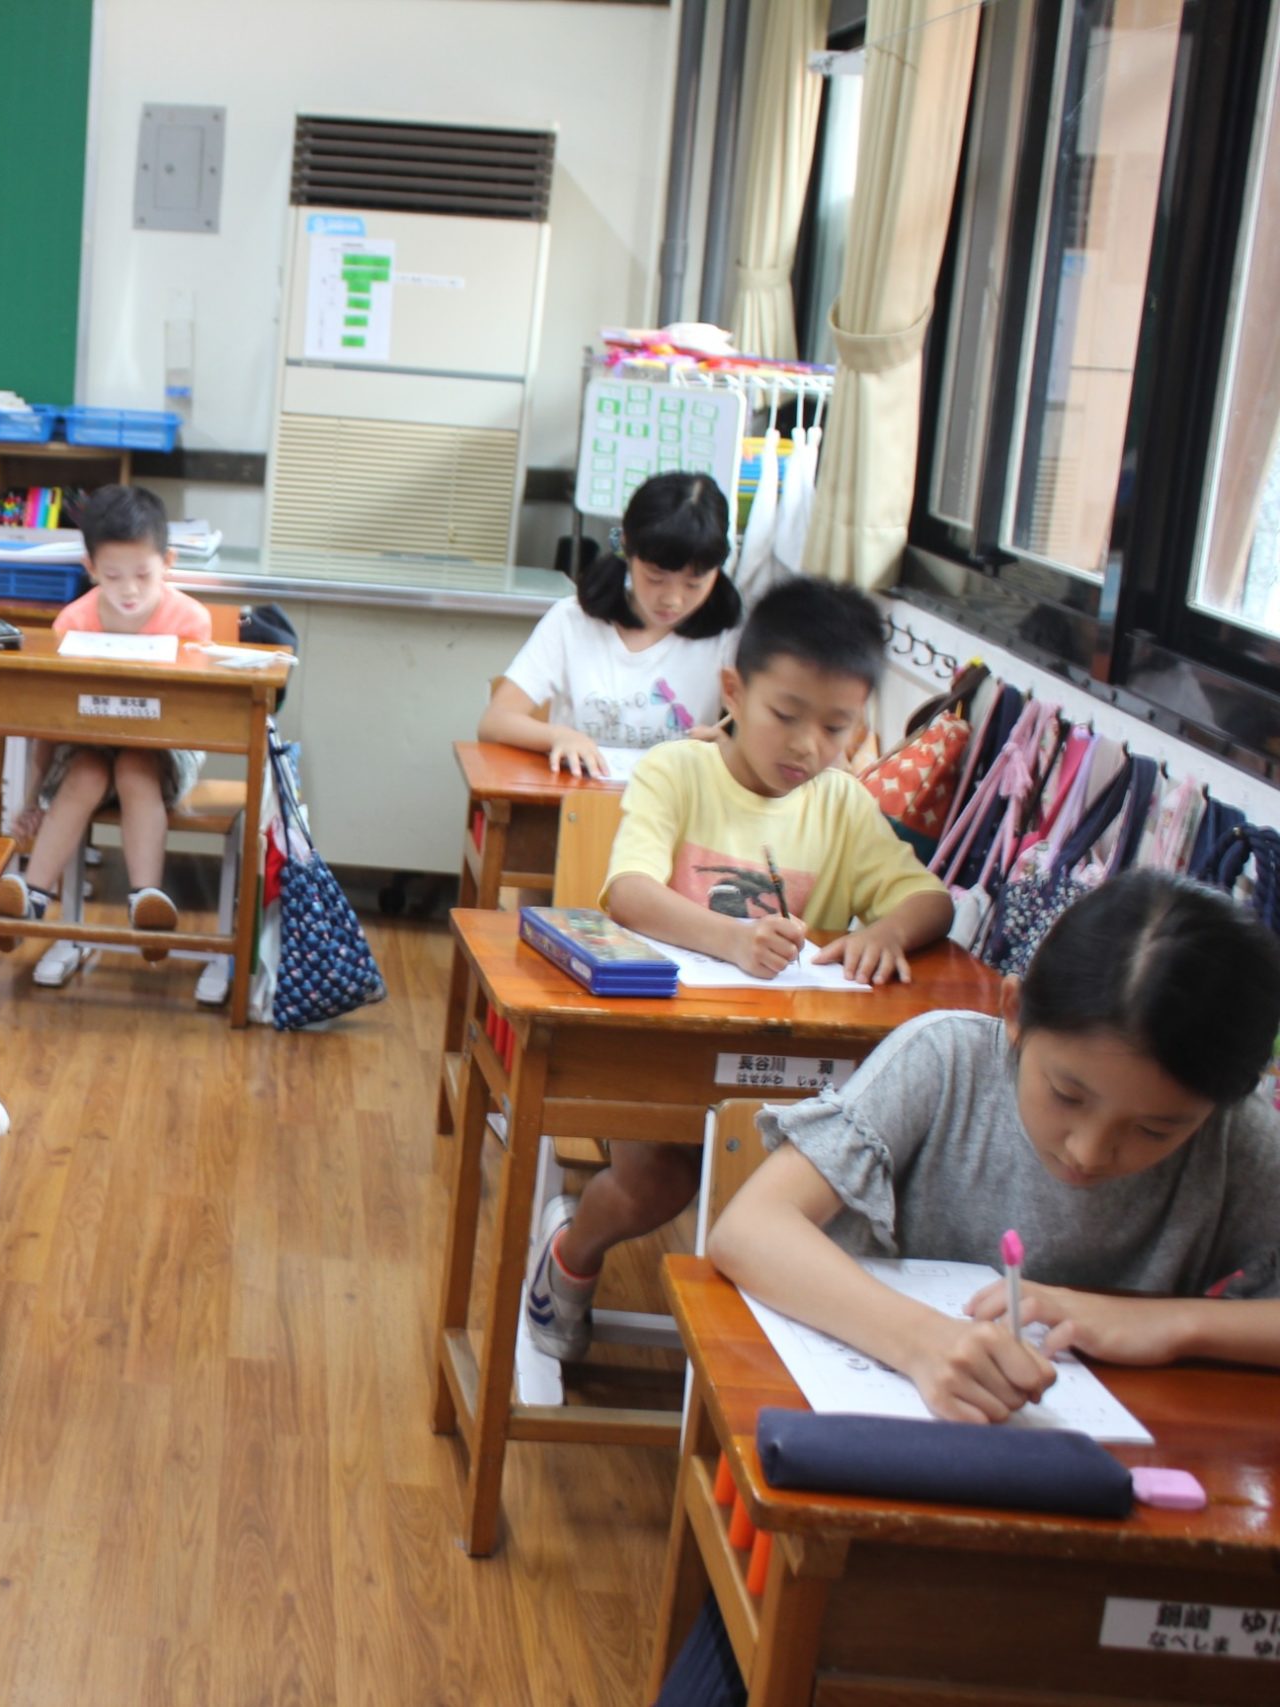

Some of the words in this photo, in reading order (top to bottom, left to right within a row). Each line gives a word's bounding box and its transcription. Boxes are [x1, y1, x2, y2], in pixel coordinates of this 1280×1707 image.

[738, 1056, 785, 1072] 長谷川
[736, 1073, 784, 1085] はせがわ
[1148, 1631, 1230, 1654] なべしま
